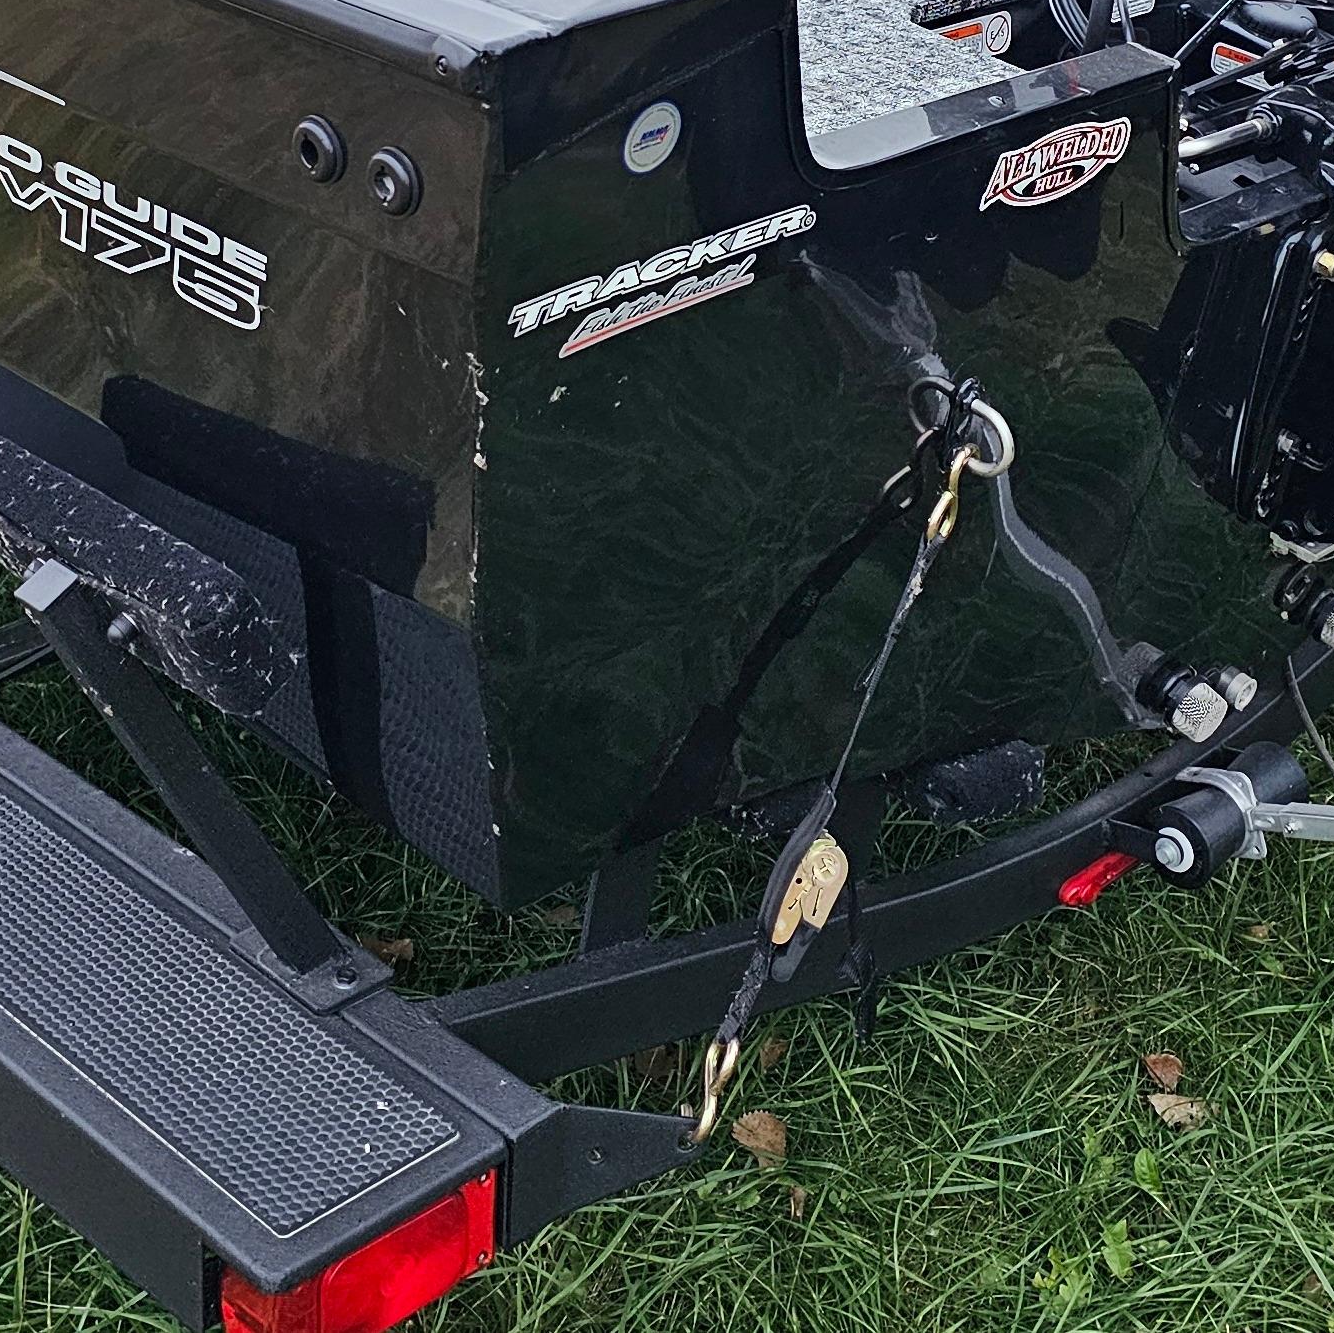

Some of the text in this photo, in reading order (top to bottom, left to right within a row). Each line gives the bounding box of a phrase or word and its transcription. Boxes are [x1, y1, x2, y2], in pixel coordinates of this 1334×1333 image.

[987, 123, 1127, 200] ALL WELDED
[1033, 169, 1073, 195] HULL
[55, 161, 267, 281] GUIDE
[574, 308, 622, 340] Fish
[627, 293, 662, 319] the
